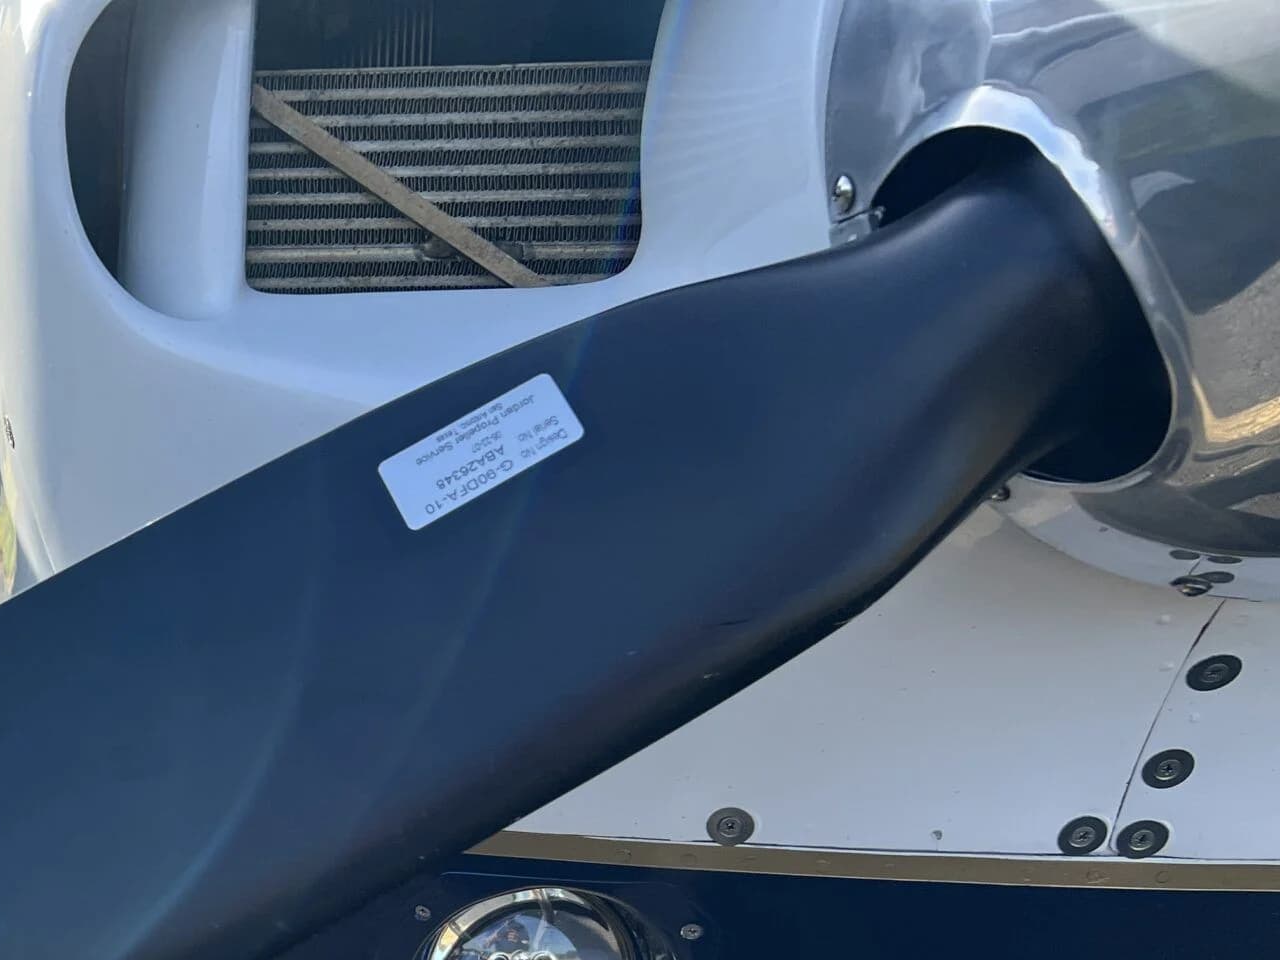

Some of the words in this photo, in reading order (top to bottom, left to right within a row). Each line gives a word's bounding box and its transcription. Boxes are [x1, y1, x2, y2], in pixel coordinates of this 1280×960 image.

[487, 402, 504, 414] San
[501, 394, 535, 418] Jordan
[455, 416, 500, 445] Propeller
[533, 415, 560, 433] Serial
[436, 429, 459, 444] Texas
[536, 428, 568, 449] Design
[415, 442, 454, 466] Service
[436, 444, 505, 490] ABA26348
